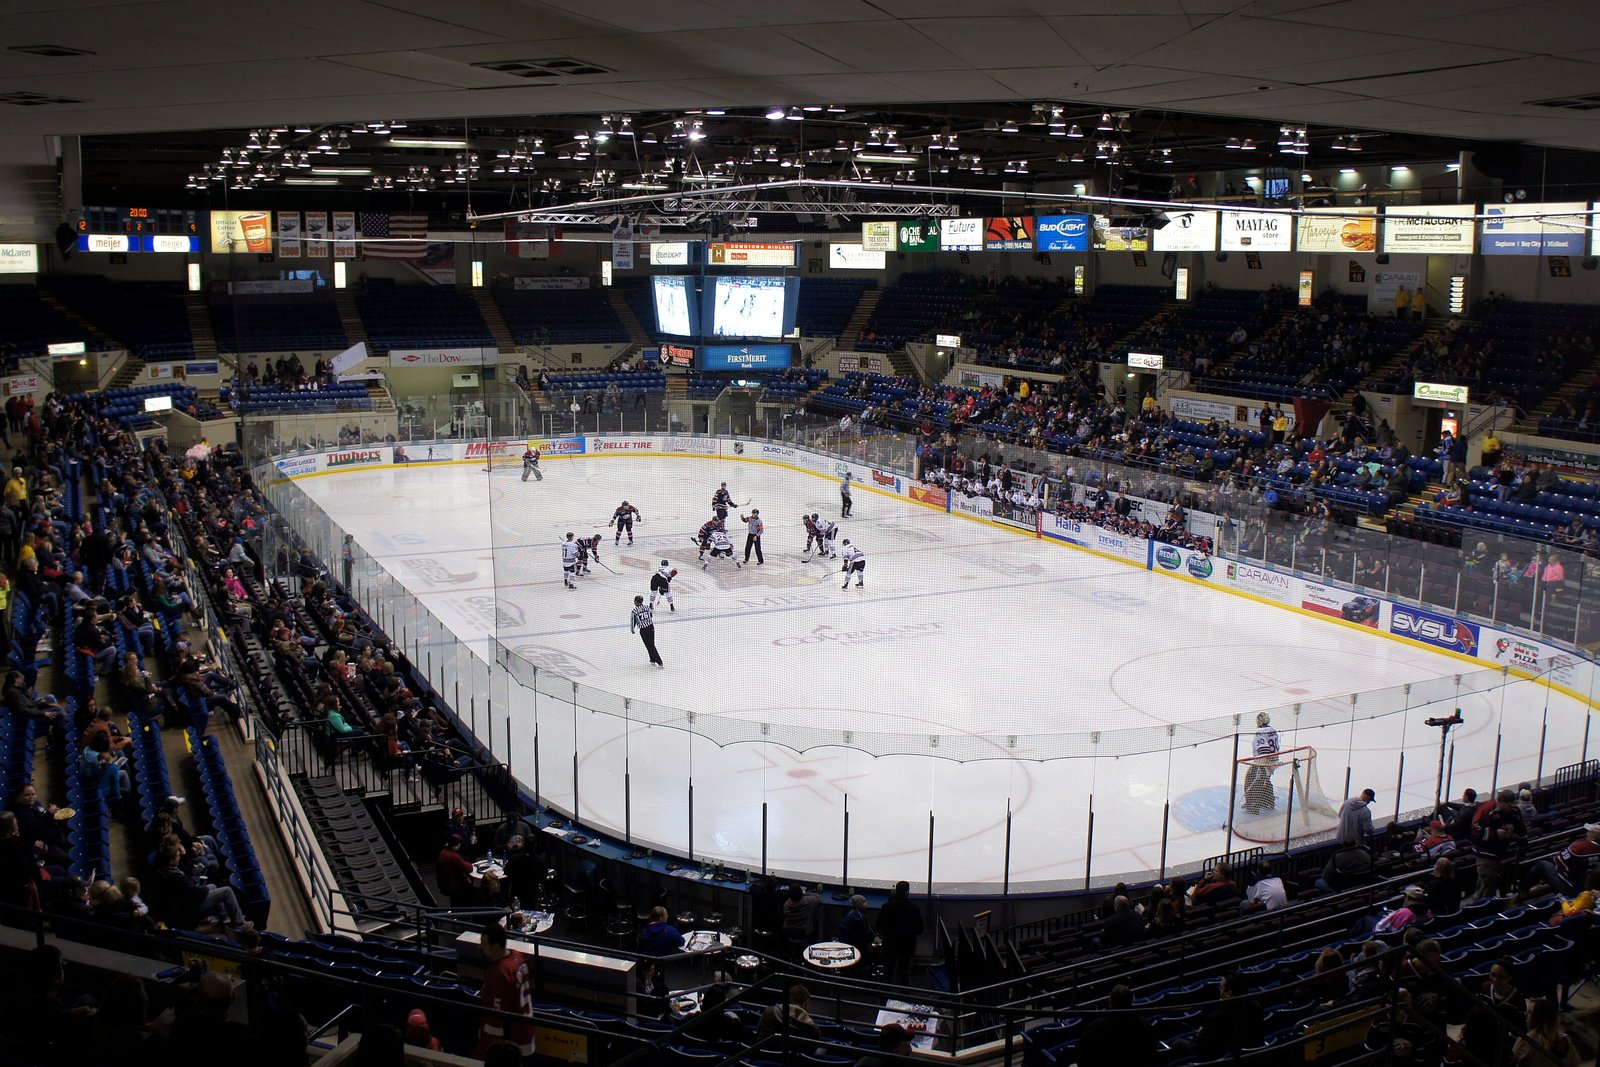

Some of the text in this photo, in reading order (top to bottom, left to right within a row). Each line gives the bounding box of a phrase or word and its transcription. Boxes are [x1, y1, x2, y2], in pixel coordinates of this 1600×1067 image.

[949, 220, 976, 233] Future
[1039, 223, 1085, 231] BUD LIGHT
[1235, 218, 1278, 231] MAYTAG
[1300, 216, 1338, 248] Harvey's
[96, 237, 121, 250] meijer
[160, 238, 183, 250] meijer
[1, 249, 31, 257] McLaren
[1553, 267, 1567, 276] 14
[420, 353, 439, 363] The
[439, 353, 461, 363] Dow
[728, 355, 768, 363] FIRSTMERIT
[327, 450, 381, 465] Timbers
[960, 501, 992, 518] Merrill Lynch
[1189, 557, 1210, 568] REDER
[1238, 566, 1289, 588] CARAVAN
[1393, 611, 1458, 644] SVSU
[1513, 653, 1538, 665] PIZZA
